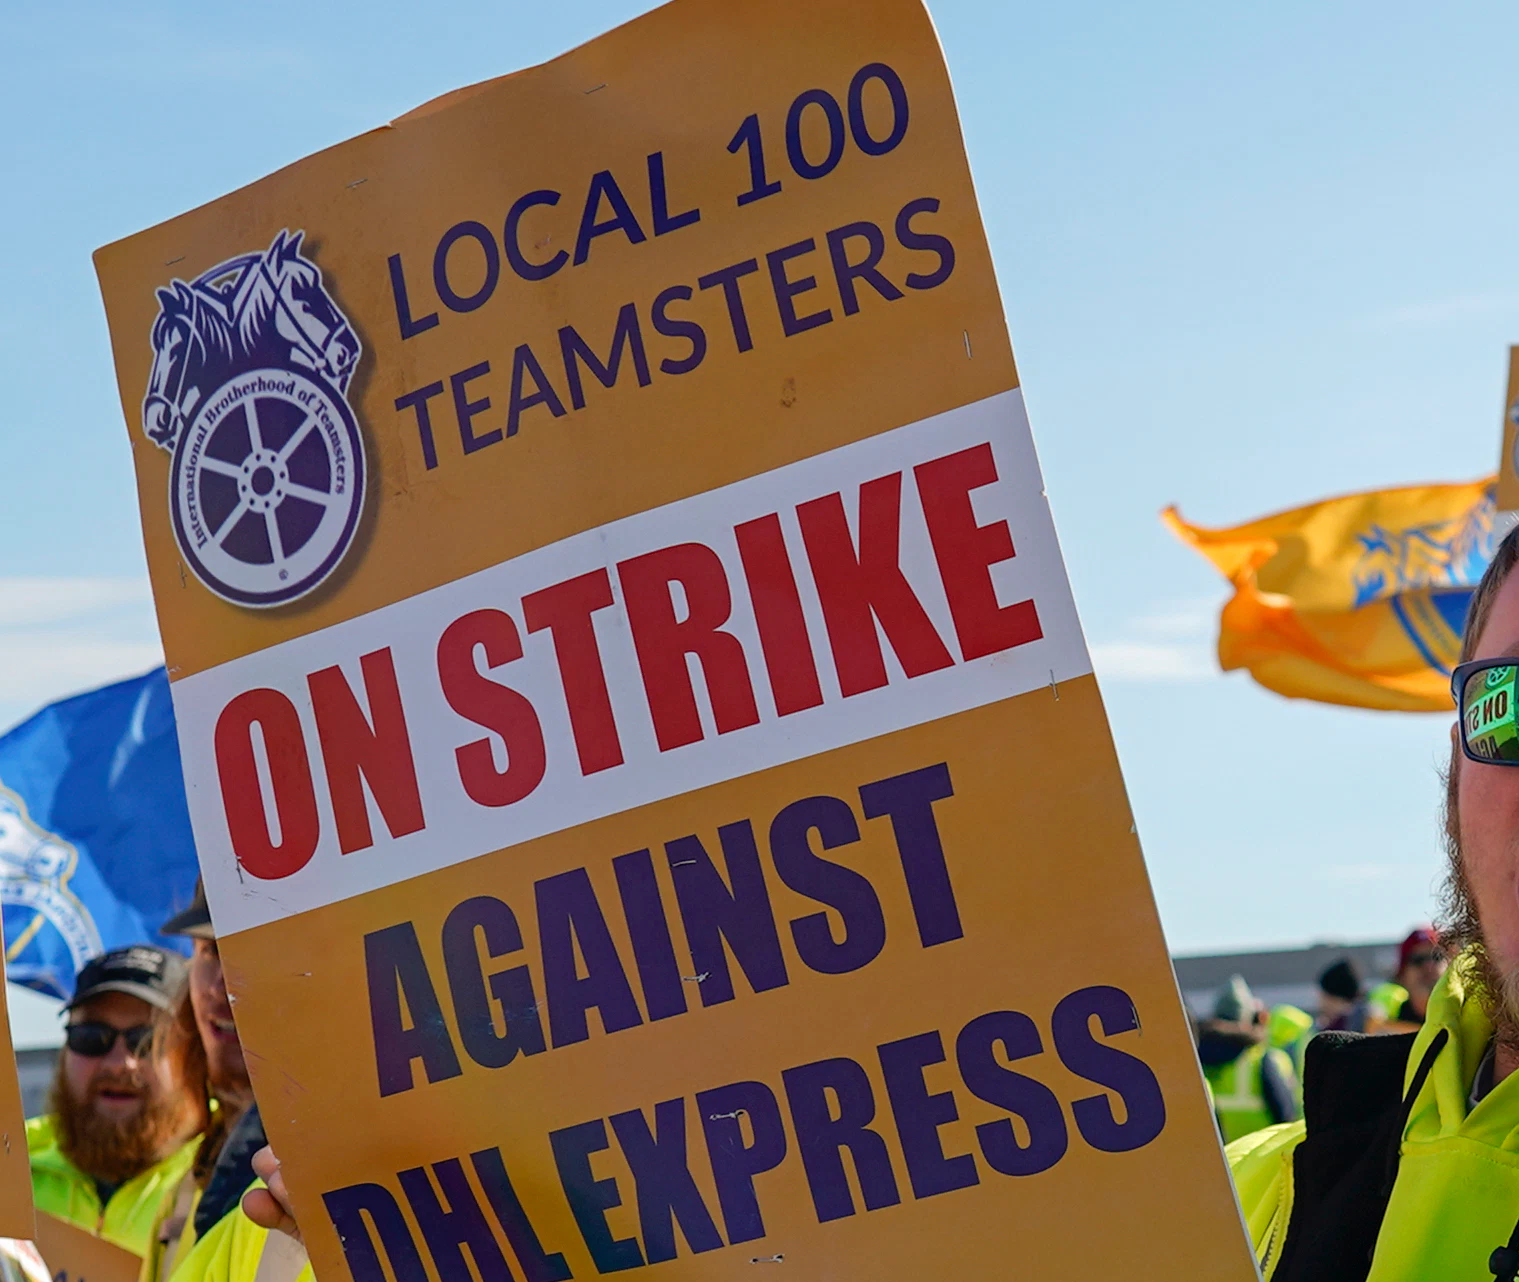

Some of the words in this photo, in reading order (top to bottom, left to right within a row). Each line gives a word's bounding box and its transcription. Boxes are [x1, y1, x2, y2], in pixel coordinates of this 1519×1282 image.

[387, 150, 702, 341] LOCAL
[725, 61, 910, 208] 100
[394, 196, 957, 472] TEAMSTERS
[185, 424, 208, 549] International
[205, 377, 296, 426] Brotherhood
[298, 390, 317, 408] of
[312, 400, 345, 495] Teamsters
[213, 645, 427, 880] ON
[436, 441, 1044, 808] STRIKE
[363, 762, 964, 1098] AGAINST
[548, 984, 1167, 1276] EXPRESS
